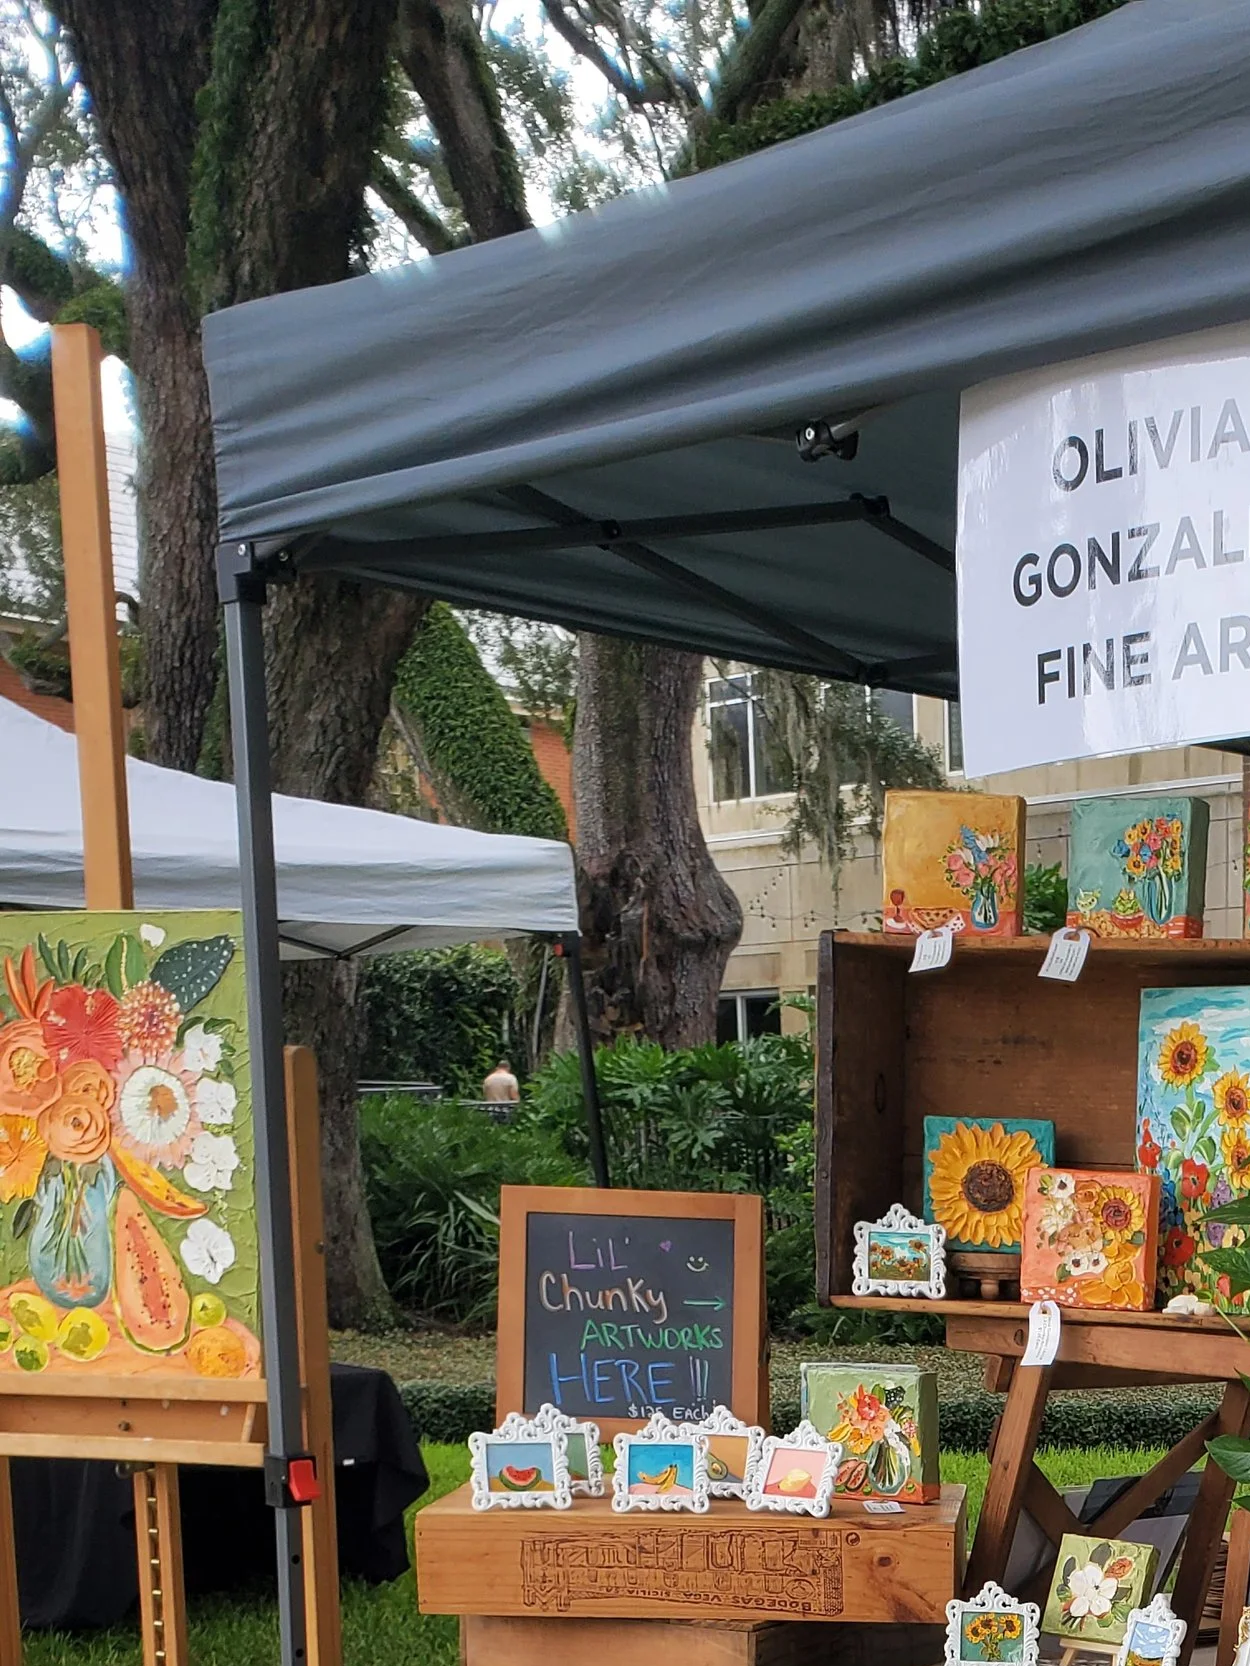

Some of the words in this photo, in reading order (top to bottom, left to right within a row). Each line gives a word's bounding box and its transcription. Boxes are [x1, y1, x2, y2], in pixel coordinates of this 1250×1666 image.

[1036, 632, 1152, 704] FINE
[581, 1320, 723, 1350] ARTWORKS
[551, 1353, 675, 1404] HERE
[683, 1592, 722, 1602] VEGA
[733, 1595, 813, 1612] BODEGAS
